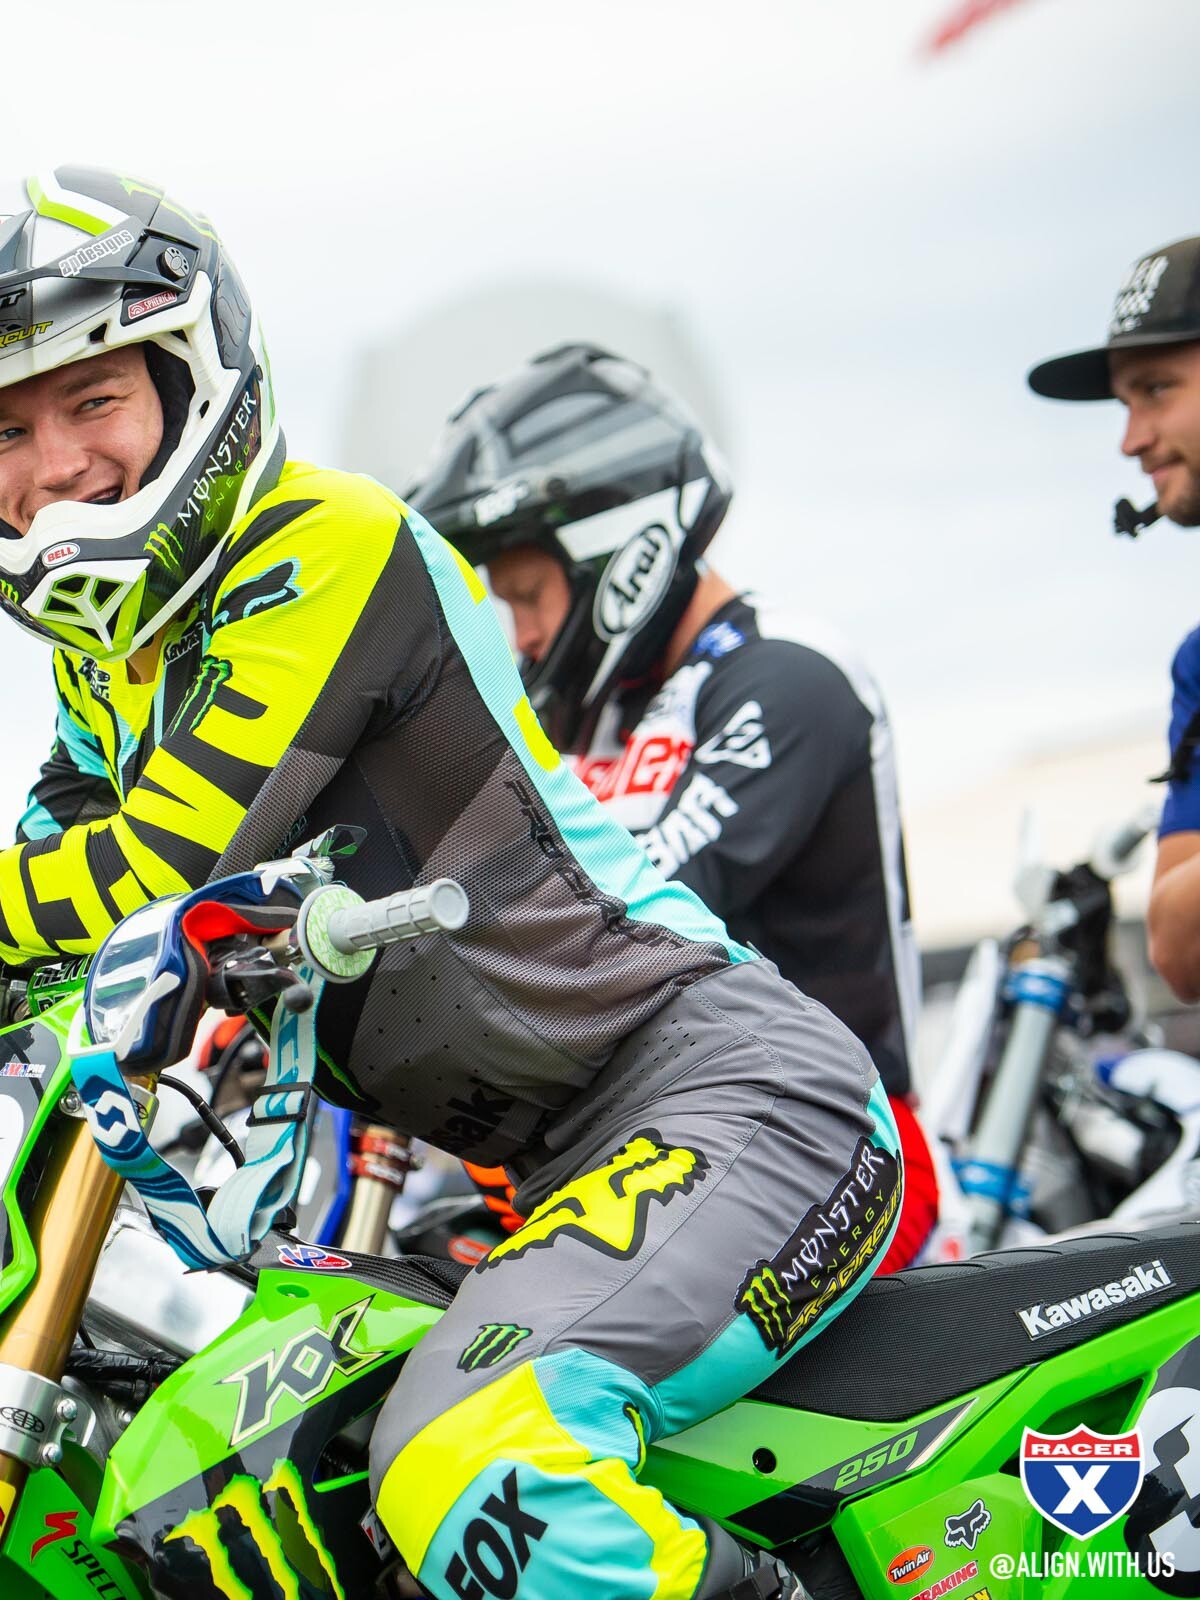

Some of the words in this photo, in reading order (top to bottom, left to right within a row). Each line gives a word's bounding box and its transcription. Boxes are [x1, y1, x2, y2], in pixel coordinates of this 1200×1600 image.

[59, 230, 134, 276] apdesigns
[144, 291, 177, 310] SPHERICAL
[47, 545, 74, 563] BELL
[781, 1145, 885, 1293] MONSTER
[811, 1189, 884, 1289] ENERGY
[1018, 1259, 1173, 1337] Kawasaki
[834, 1430, 919, 1491] 250
[444, 1467, 548, 1600] FOX
[891, 1560, 916, 1581] Twin
[916, 1549, 932, 1568] Air
